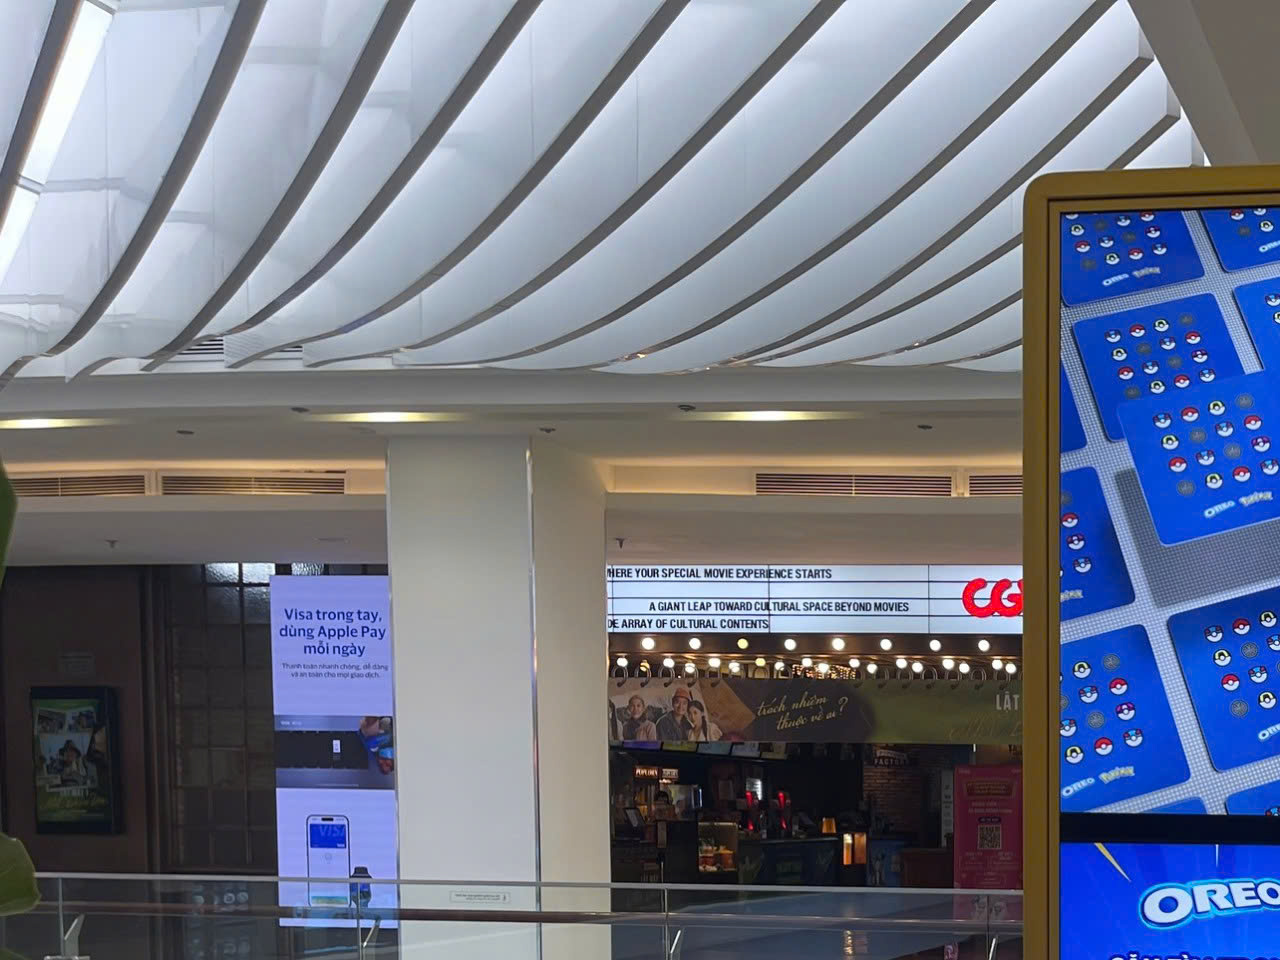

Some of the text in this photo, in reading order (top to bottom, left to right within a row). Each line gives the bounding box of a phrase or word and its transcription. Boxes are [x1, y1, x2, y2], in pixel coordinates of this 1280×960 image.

[635, 568, 659, 578] YOUR
[661, 568, 701, 578] SPECIAL
[703, 568, 734, 579] MOVIE
[736, 568, 793, 579] EXPERIENCE
[795, 568, 832, 579] STARTS
[649, 601, 909, 612] A GIANT LEAP TOWARD CULTURAL SPACE BEYOND MOVIES
[962, 578, 1024, 619] CG
[284, 608, 382, 624] Visa trong tay,
[621, 619, 653, 629] ARRAY
[655, 619, 668, 629] OF
[670, 619, 717, 629] CULTURAL
[720, 619, 769, 629] CONTENTS
[279, 624, 386, 641] dùng Apple Pay
[303, 640, 366, 658] mỗi ngày
[319, 662, 339, 671] nhanh
[996, 691, 1020, 713] LẬT
